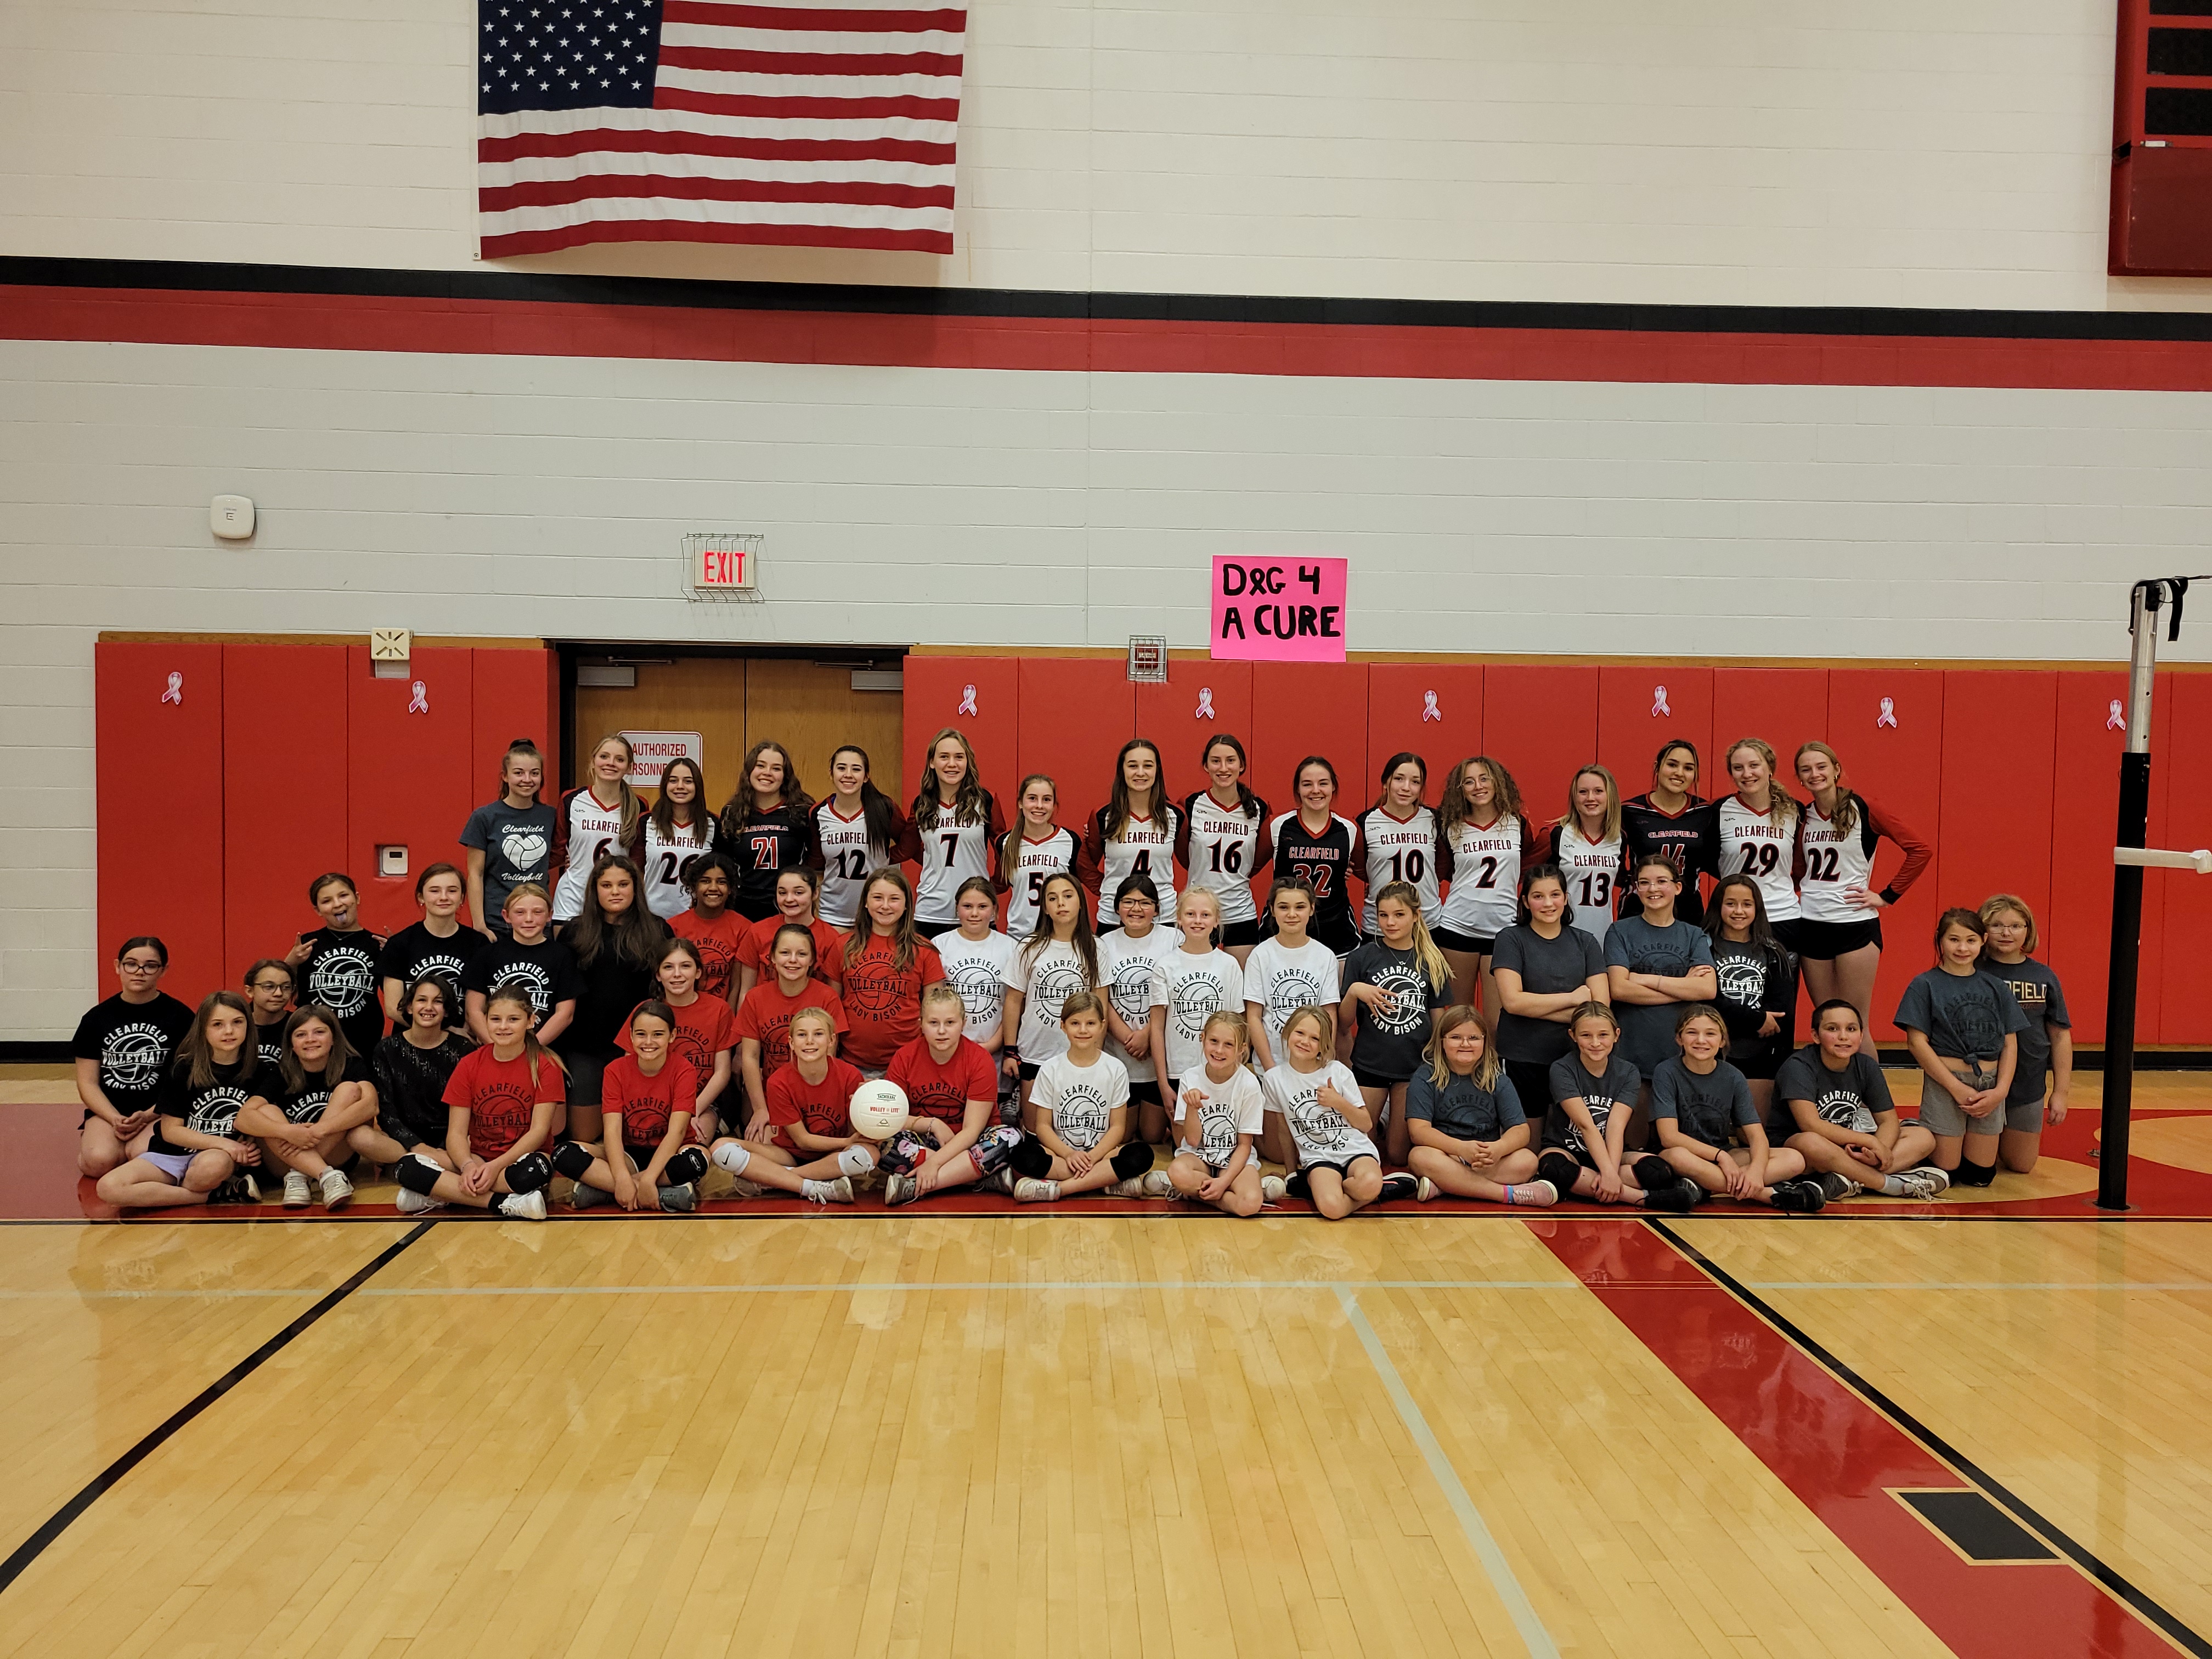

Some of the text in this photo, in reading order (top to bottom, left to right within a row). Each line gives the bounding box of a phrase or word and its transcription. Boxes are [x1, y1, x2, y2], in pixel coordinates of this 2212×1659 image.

[704, 552, 745, 583] EXIT
[1299, 566, 1320, 594] 4
[1222, 605, 1341, 640] A CURE
[633, 743, 686, 757] AUTHORIZED
[502, 824, 544, 834] Clearfield
[827, 832, 869, 845] CLEARFIEL
[1204, 821, 1249, 836] CLEARFIELD
[1380, 833, 1427, 845] CLEARFIELD
[1648, 830, 1699, 838] CLEARFIELD
[1734, 825, 1784, 839] CLEARFIELD
[752, 837, 778, 870] 21
[940, 833, 959, 867] 7
[1207, 837, 1244, 874] 16
[1289, 847, 1339, 860] CLEARFIELD
[1463, 839, 1511, 854] CLEARFIELD
[833, 847, 868, 880] 12
[1018, 854, 1058, 868] LEARFIELD
[1130, 849, 1153, 876] 4
[1388, 847, 1425, 884] 10
[1574, 854, 1616, 868] CLEARFIELD
[1740, 842, 1780, 877] 29
[1808, 847, 1841, 882] 22
[1293, 864, 1332, 898] 32
[1475, 856, 1498, 889] 2
[1029, 872, 1043, 906] 5
[1578, 870, 1611, 907] 13
[313, 947, 374, 968] CLEARFIELD
[695, 938, 731, 957] ARFIELD
[410, 955, 465, 977] CLEARFIEL
[493, 962, 550, 985] CLEARFIELD
[948, 958, 1001, 976] CLEARFIELD
[1037, 960, 1090, 979] CLEARFIELD
[309, 974, 374, 991] VOLLEYBALL
[848, 978, 908, 997] VOLLEYBALL
[1173, 972, 1223, 994] CLEARFIELD
[1271, 968, 1320, 989] CLEARFIELD
[1372, 966, 1427, 989] CLEARFIELD
[1111, 984, 1149, 997] VOLLEYB
[337, 997, 366, 1018] BISON
[850, 1000, 902, 1022] LADY BISON
[972, 1006, 997, 1025] BISON
[1036, 1008, 1056, 1028] LADY
[103, 1022, 168, 1046] CLEARFIELD
[676, 1026, 709, 1046] RFIELD
[1175, 1023, 1196, 1042] LADY
[1394, 1016, 1423, 1035] BISON
[193, 1087, 248, 1110] CLEARFIEL
[474, 1082, 532, 1105] CLEARFIELD
[1059, 1084, 1107, 1108] CLEARFIELD
[1583, 1095, 1612, 1108] EARFIE
